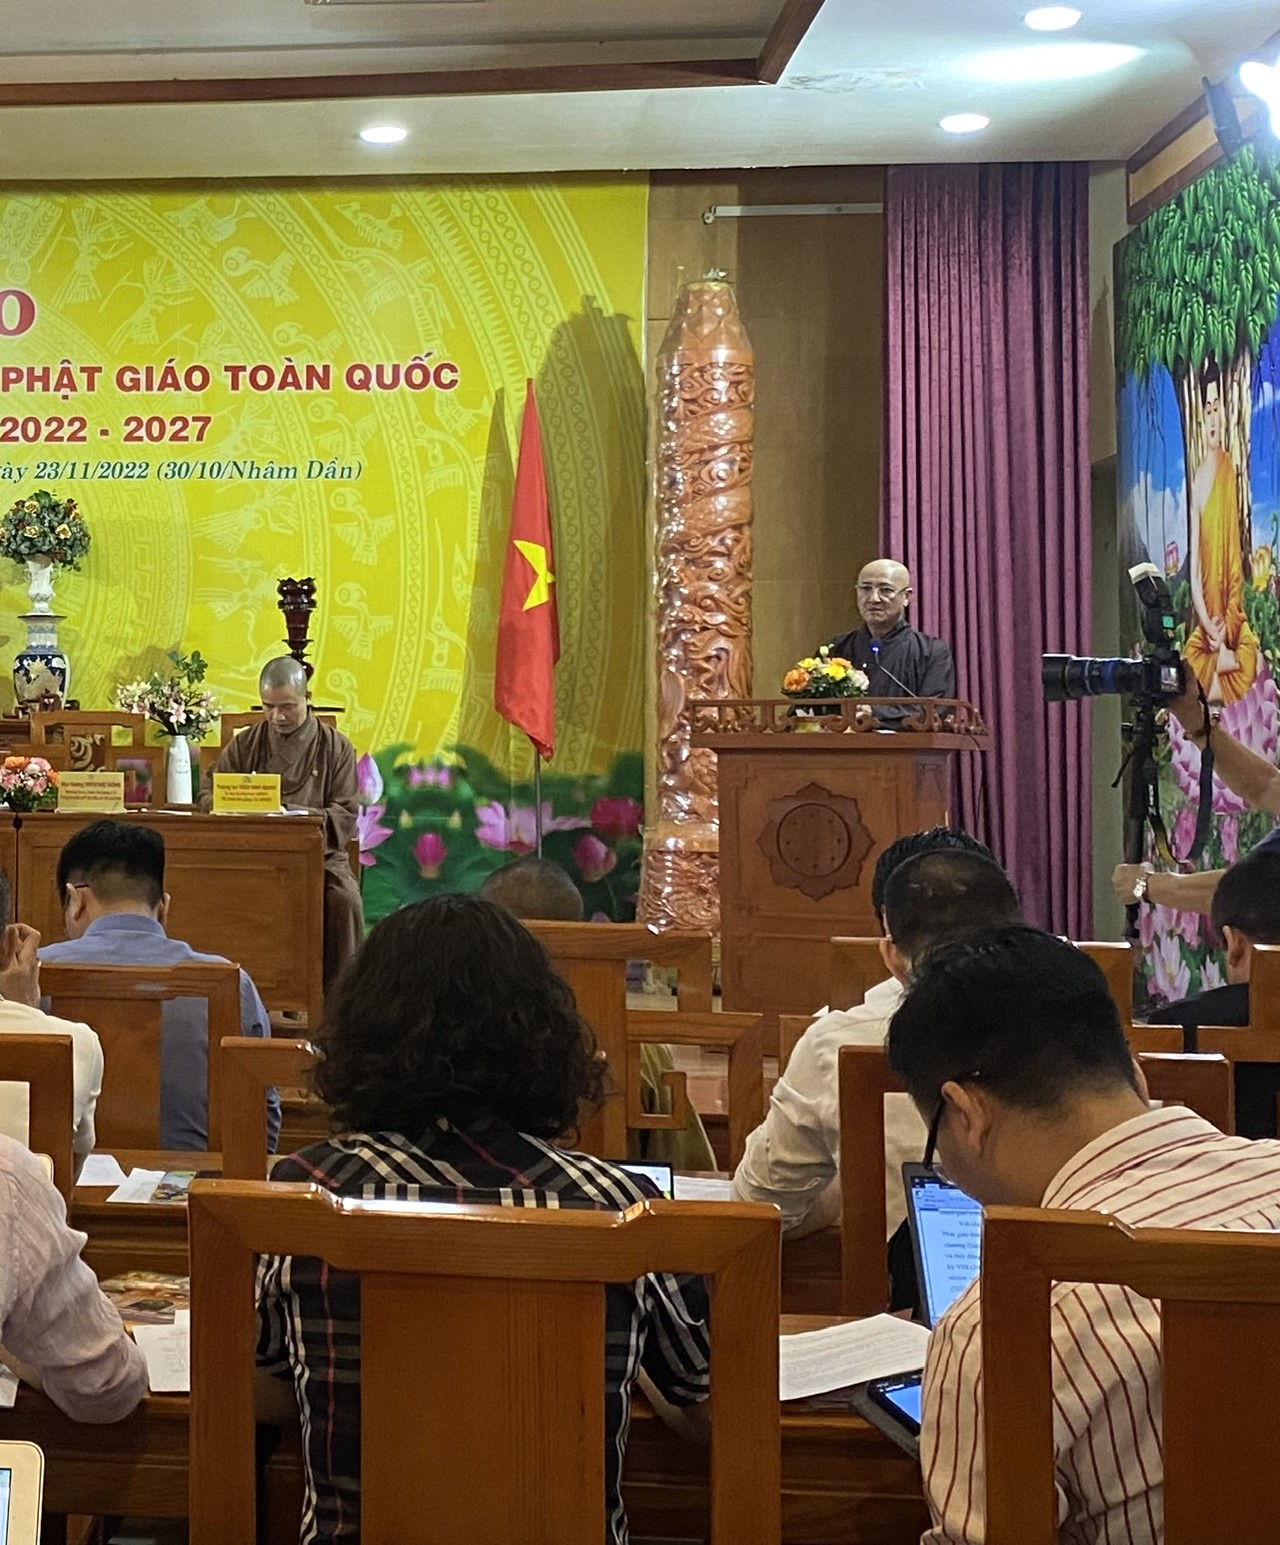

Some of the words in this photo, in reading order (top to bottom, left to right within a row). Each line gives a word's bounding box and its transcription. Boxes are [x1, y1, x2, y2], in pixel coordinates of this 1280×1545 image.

[1, 359, 104, 401] PHẬT
[116, 358, 211, 393] GIÁO
[224, 357, 332, 392] TOÀN
[345, 352, 460, 392] QUỐC
[0, 416, 89, 444] 2022
[123, 416, 214, 444] 2027
[34, 461, 151, 480] 23/11/2022
[157, 460, 298, 481] (30/10/Nhâm
[306, 457, 363, 480] Dần)
